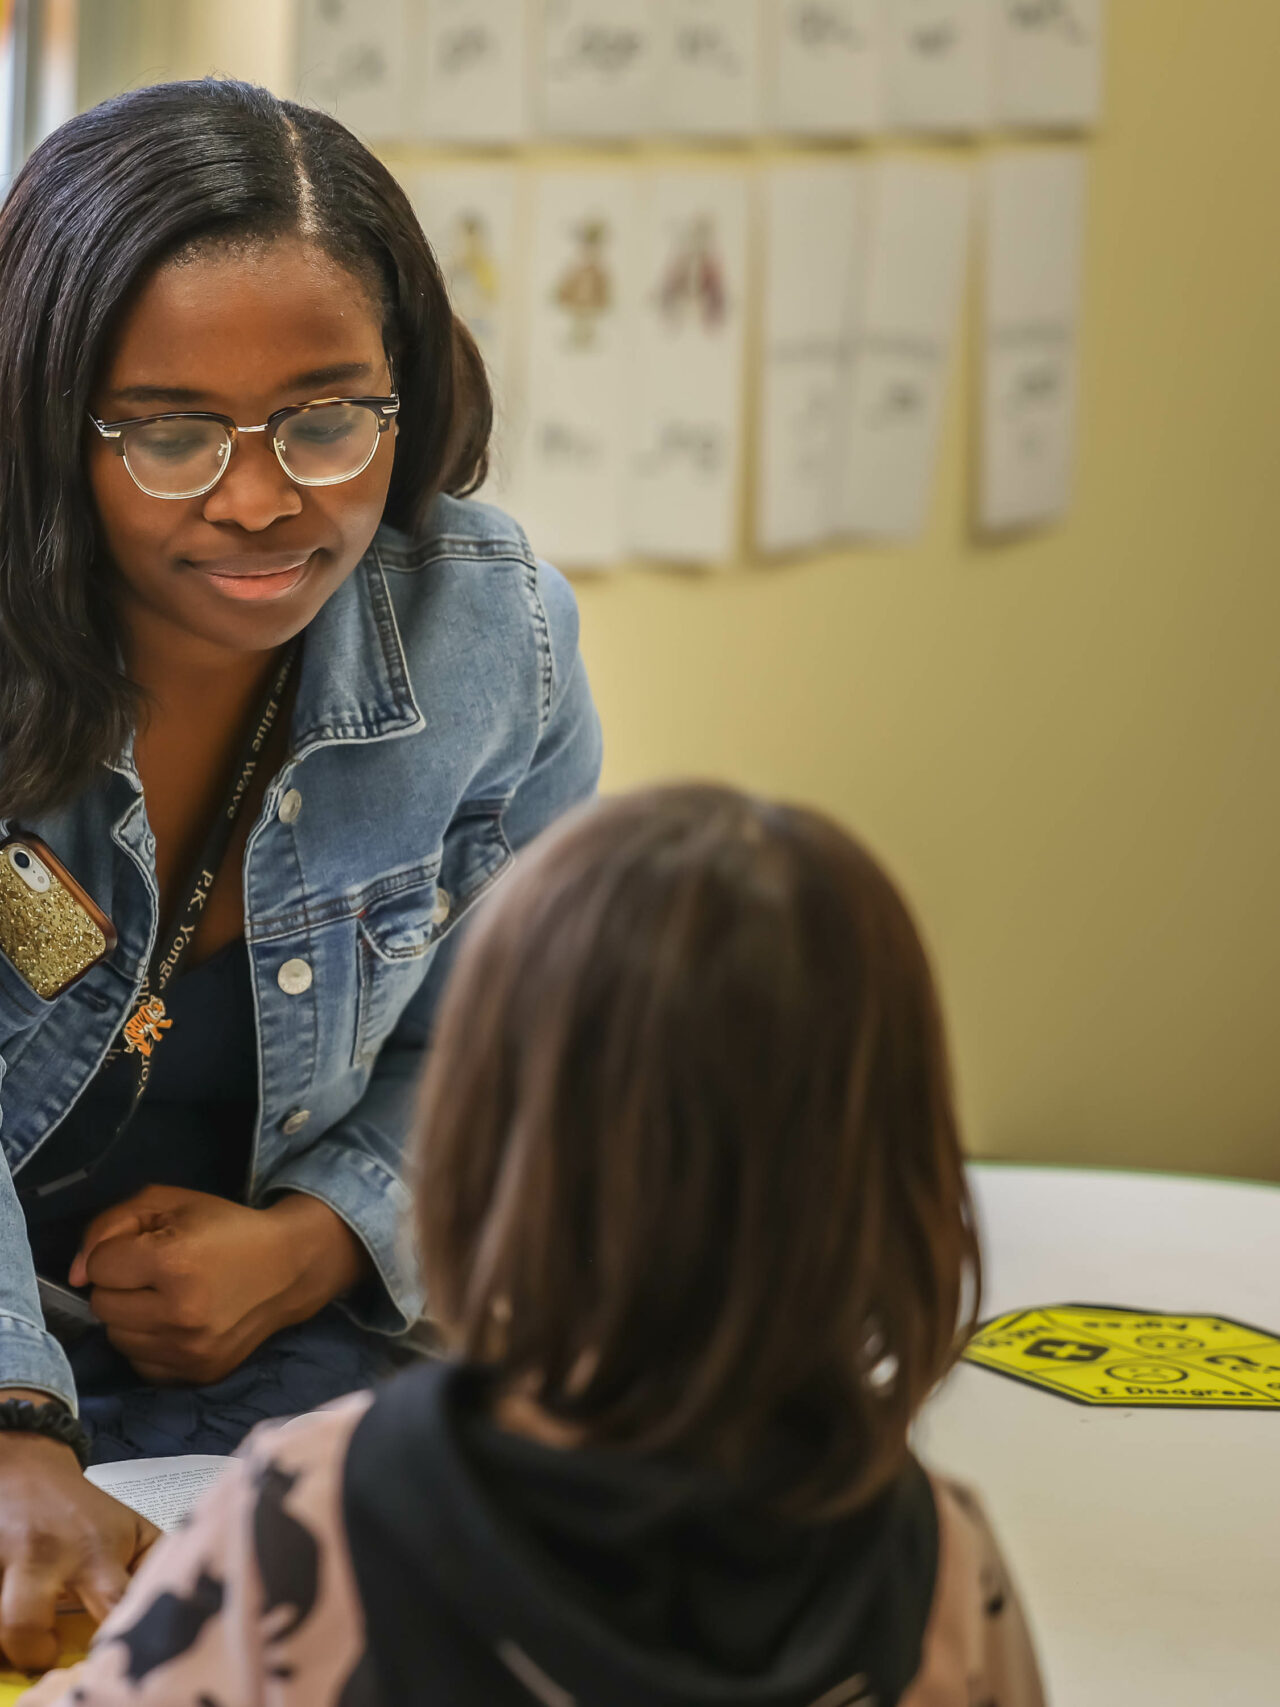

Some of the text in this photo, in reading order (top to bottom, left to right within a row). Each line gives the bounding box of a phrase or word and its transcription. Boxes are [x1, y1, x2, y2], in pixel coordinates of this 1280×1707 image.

[227, 699, 279, 819] Blue Wave
[159, 869, 214, 990] P.K. Yonge
[1094, 1386, 1254, 1397] I Disagree
